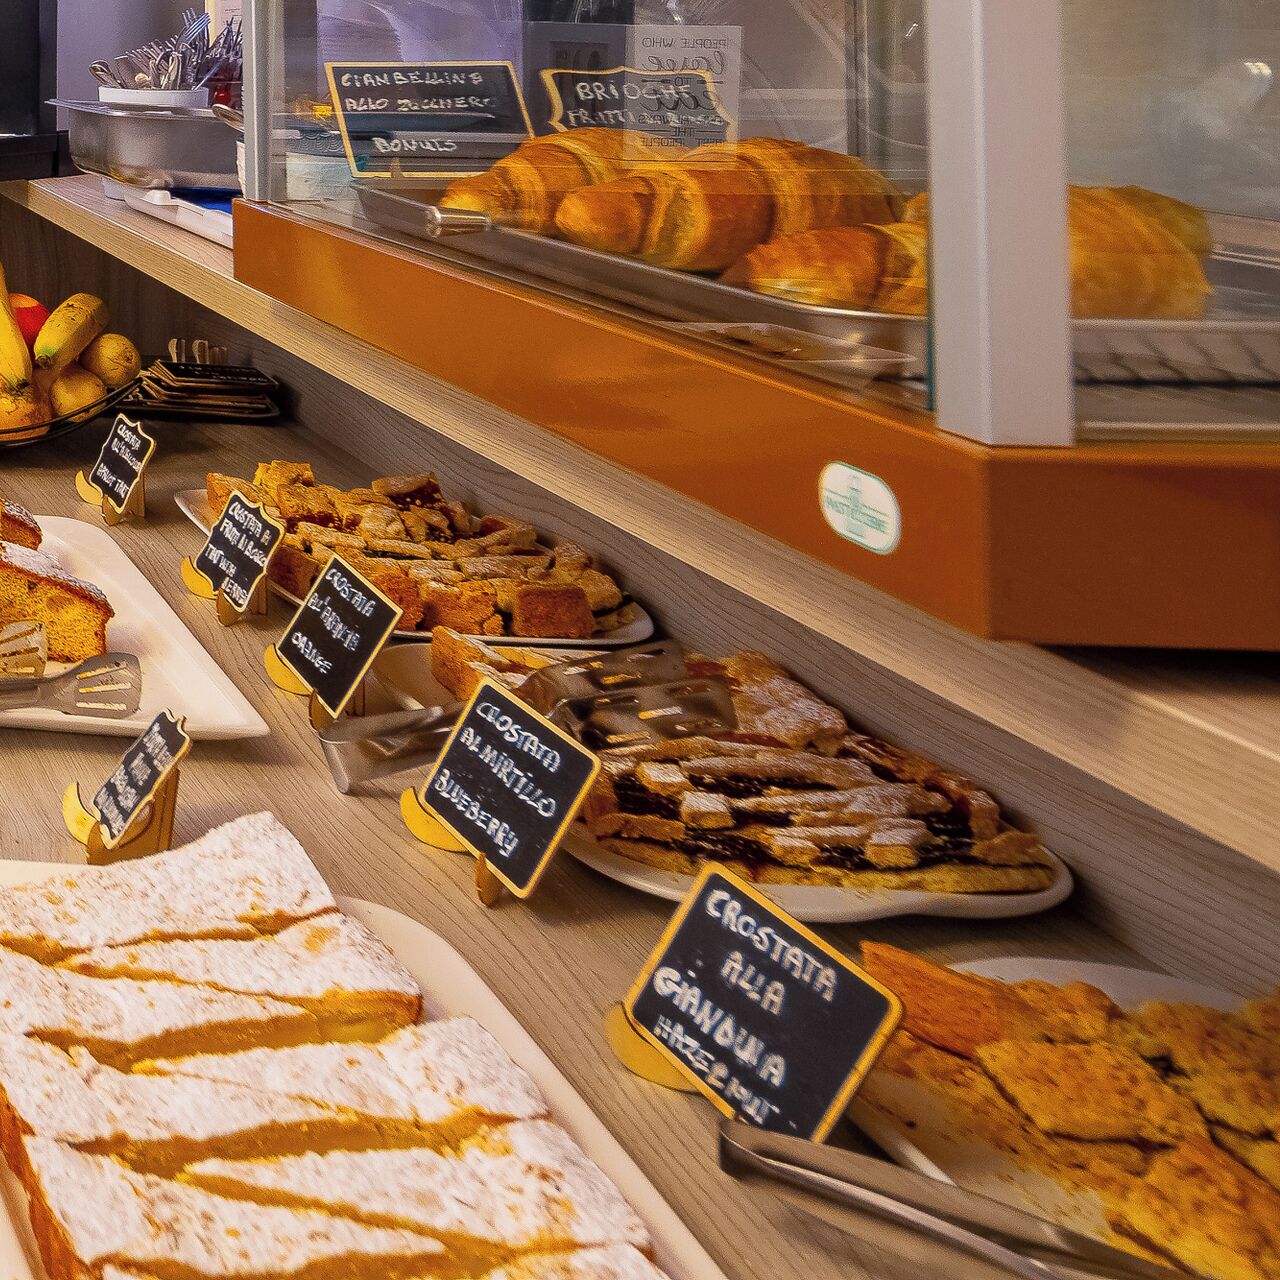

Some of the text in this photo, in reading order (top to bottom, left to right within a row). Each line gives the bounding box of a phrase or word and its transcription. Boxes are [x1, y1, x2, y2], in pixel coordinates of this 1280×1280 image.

[345, 97, 389, 112] ALLO
[576, 80, 691, 100] BRIOCHE
[228, 501, 263, 538] CROSTATA
[325, 568, 376, 617] CROSTATA
[459, 726, 479, 753] AL
[475, 702, 561, 773] CROSTATA
[435, 768, 520, 858] BLUEBERRY
[705, 888, 838, 1003] CROSTATA
[720, 950, 786, 1016] ALLA
